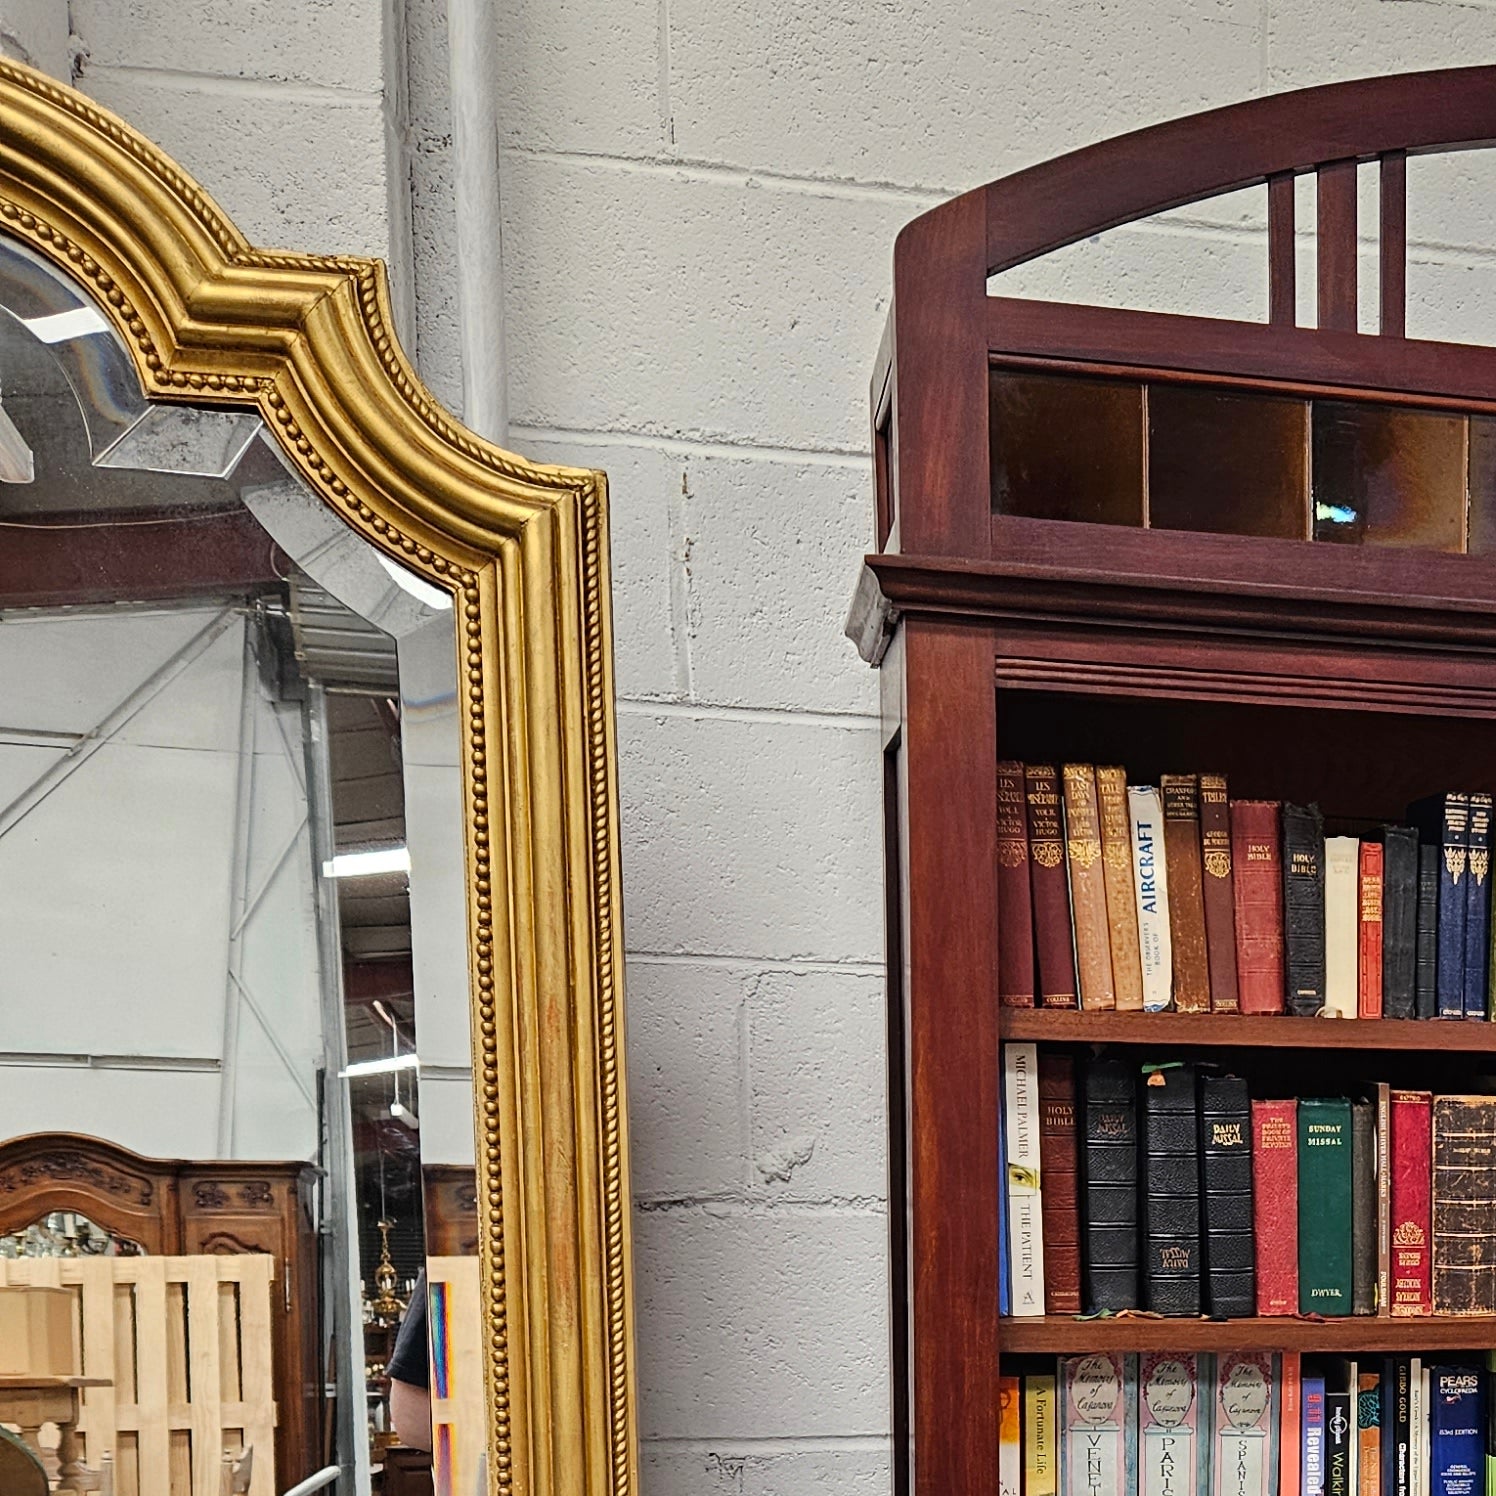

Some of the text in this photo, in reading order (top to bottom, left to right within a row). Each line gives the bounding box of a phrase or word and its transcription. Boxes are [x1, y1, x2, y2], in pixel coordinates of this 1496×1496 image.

[1248, 844, 1270, 853] HOLY
[1247, 852, 1271, 861] BIBLE
[1293, 854, 1315, 863] HOLY
[1136, 820, 1158, 914] AIRCRAFT
[1291, 863, 1316, 874] BIBLE
[1153, 932, 1162, 966] BOOK OF
[1016, 1055, 1028, 1158] MICHAEL PALMER
[1048, 1106, 1074, 1116] HOLY
[1213, 1124, 1239, 1134] DAILY
[1309, 1125, 1341, 1133] SUNDAY
[1212, 1133, 1243, 1145] MISSAL
[1308, 1137, 1341, 1146] MISSAL
[1021, 1205, 1032, 1280] THE PATIENT
[1311, 1288, 1342, 1297] DWYER
[1440, 1376, 1477, 1387] PEARS
[1399, 1366, 1407, 1422] GIBBO GOLD
